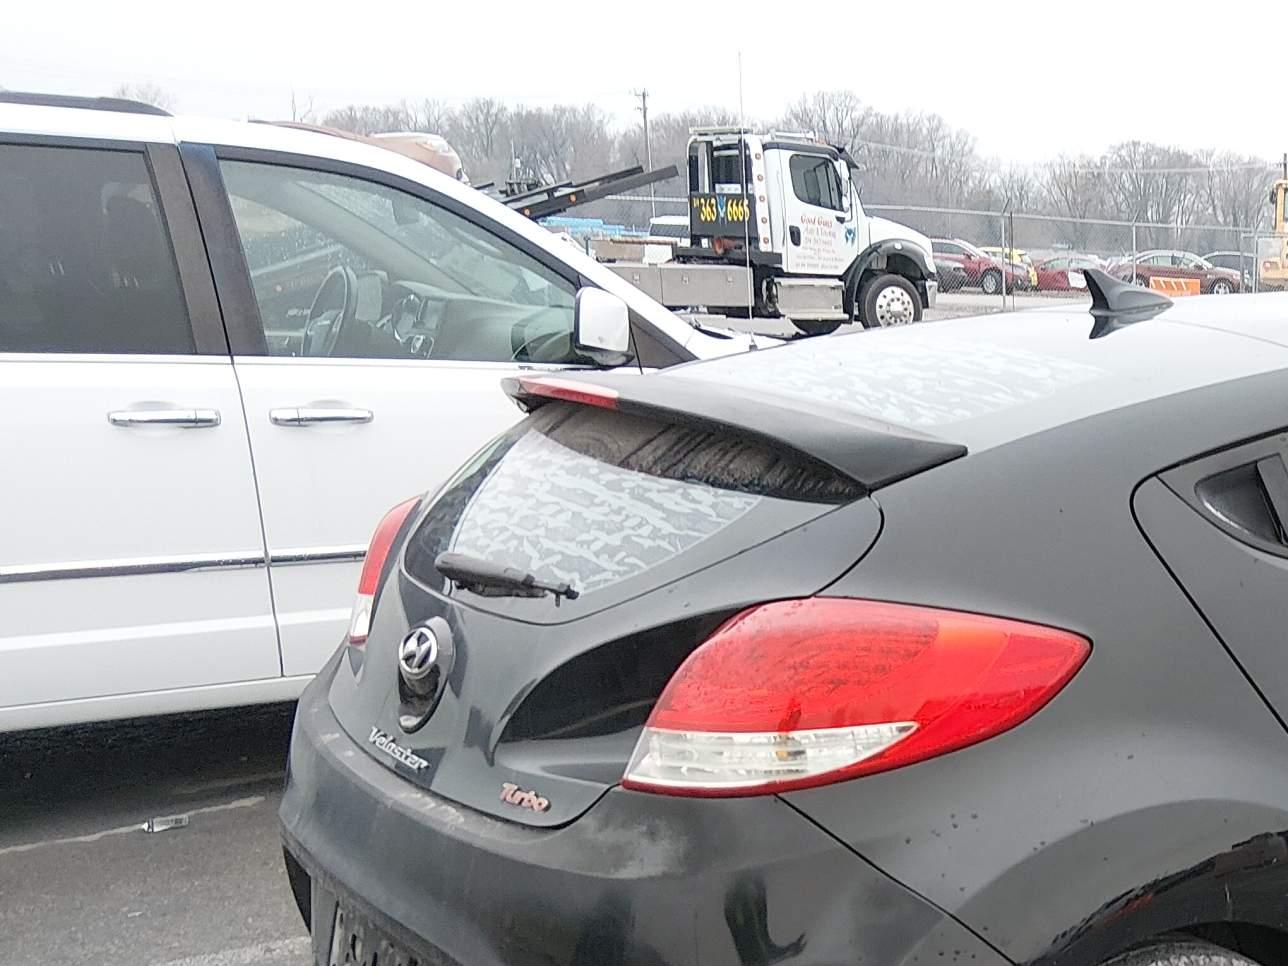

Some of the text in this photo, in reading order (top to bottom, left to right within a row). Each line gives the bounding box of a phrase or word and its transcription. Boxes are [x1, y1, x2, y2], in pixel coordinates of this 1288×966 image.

[700, 197, 717, 221] 363
[368, 726, 429, 770] Veloster
[500, 782, 550, 811] Turbo
